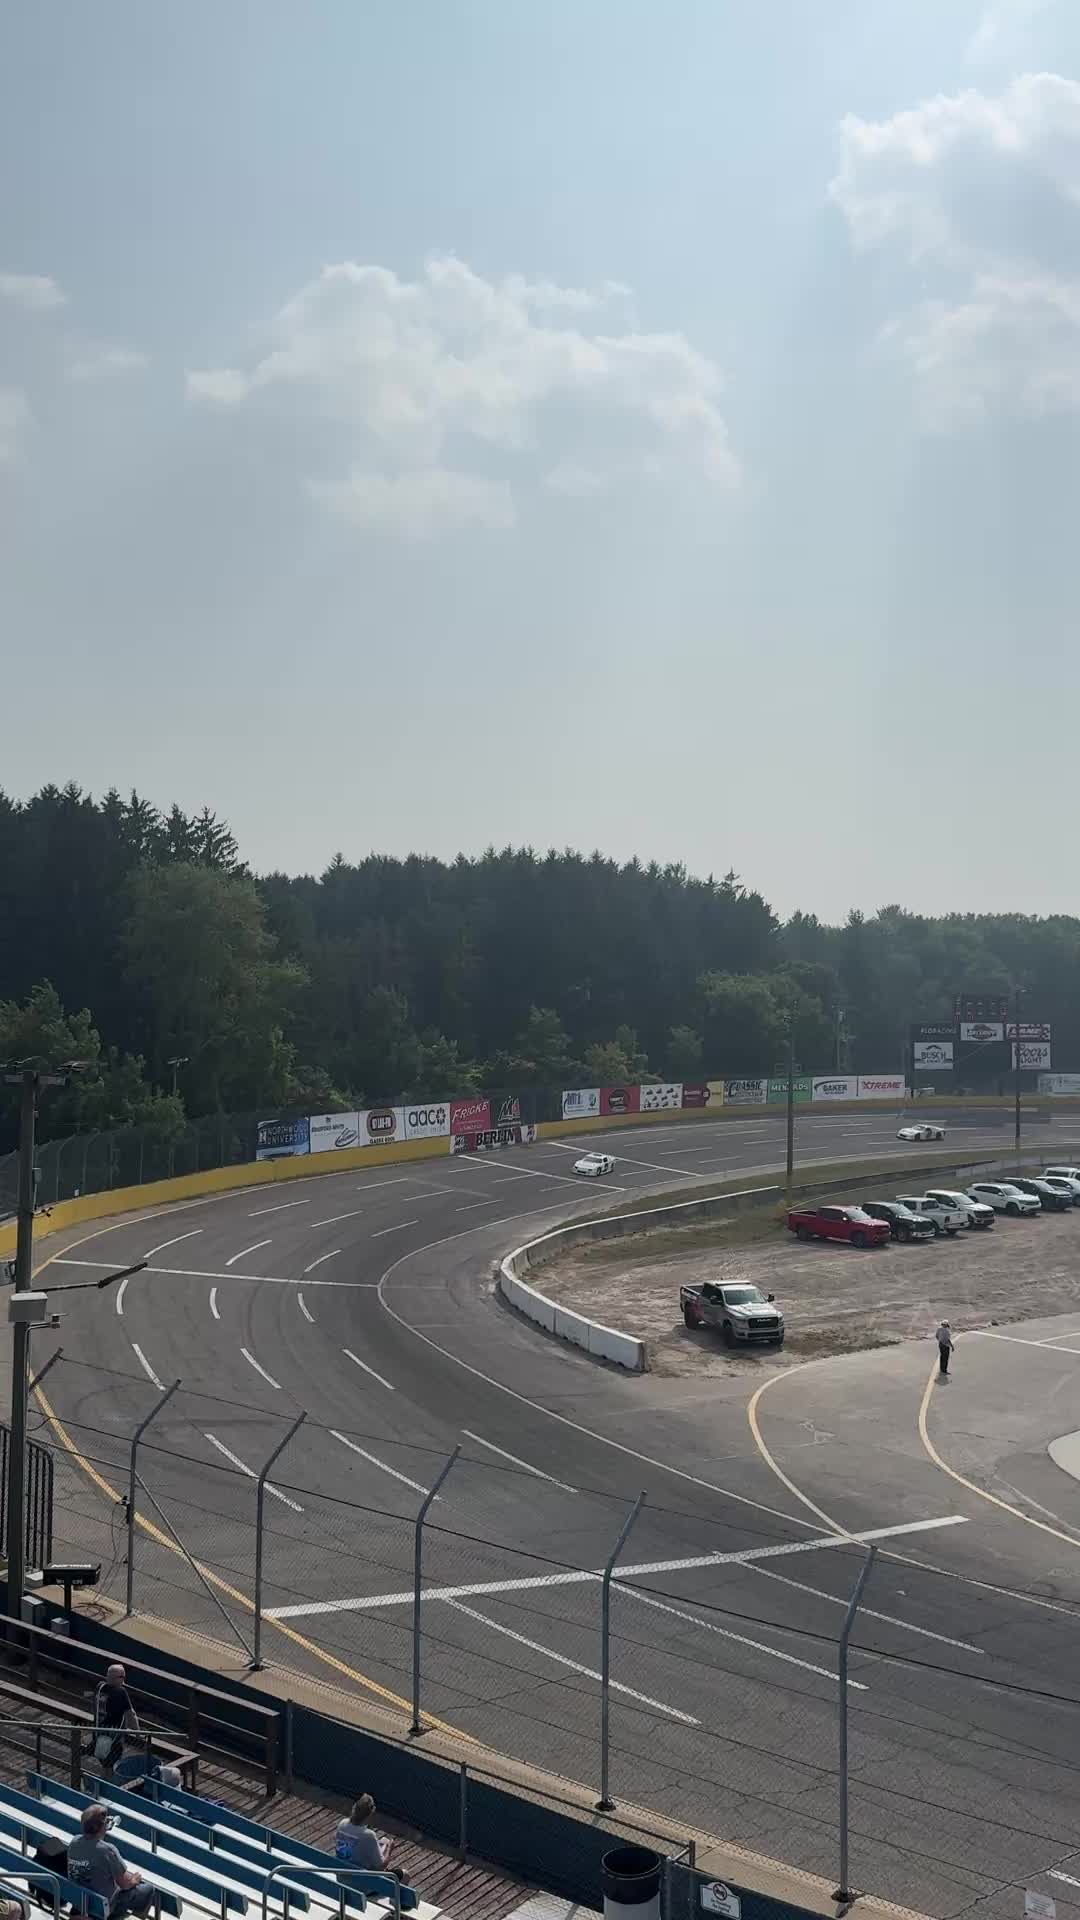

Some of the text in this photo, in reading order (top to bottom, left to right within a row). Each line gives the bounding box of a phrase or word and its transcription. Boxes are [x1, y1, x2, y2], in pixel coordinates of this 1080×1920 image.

[920, 1051, 946, 1060] BUSCH
[771, 1083, 808, 1091] MENRDS
[823, 1084, 848, 1092] BAKER
[863, 1081, 901, 1089] XTREME
[452, 1102, 488, 1123] FRICKE
[267, 1132, 308, 1145] UNIVERSITY
[476, 1128, 514, 1146] BERLIN
